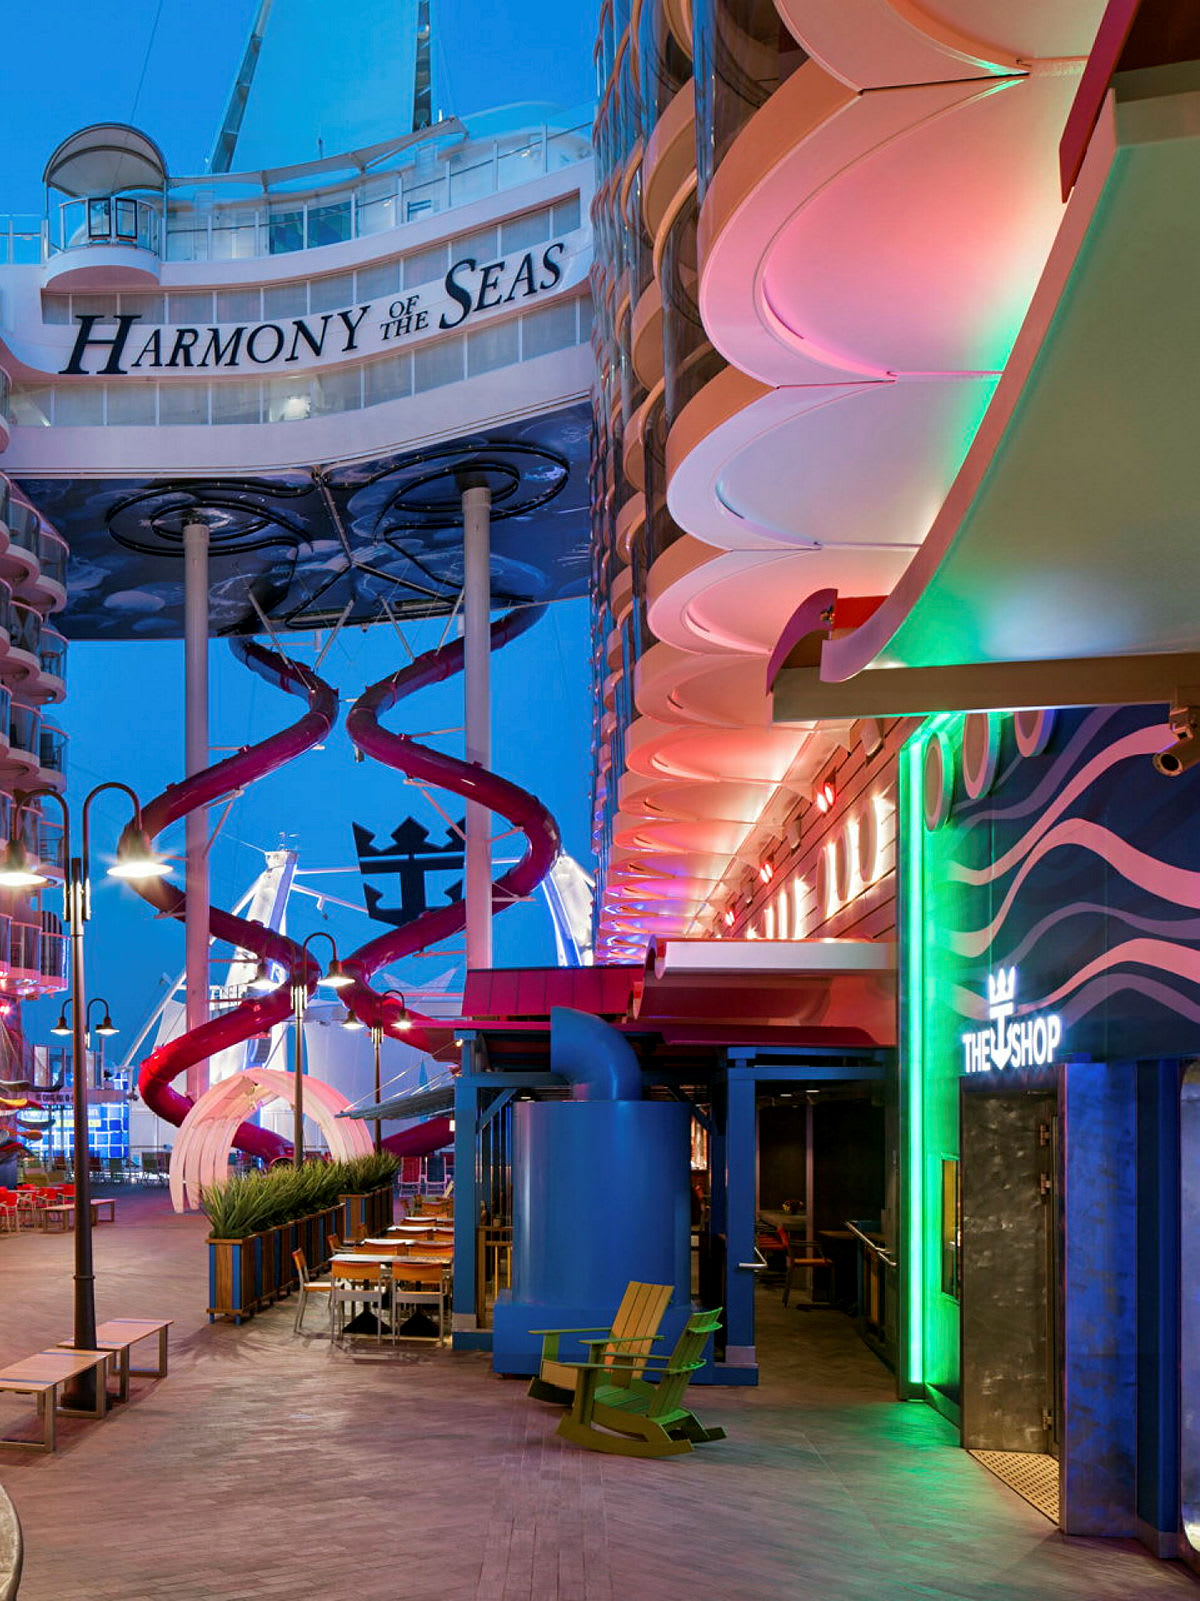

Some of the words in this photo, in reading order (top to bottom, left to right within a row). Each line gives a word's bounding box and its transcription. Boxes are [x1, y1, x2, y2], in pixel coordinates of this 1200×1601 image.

[388, 294, 420, 319] OF
[439, 242, 566, 330] SEAS
[58, 304, 370, 375] HARMONY
[379, 309, 430, 341] THE
[962, 1030, 991, 1073] THE
[1010, 1014, 1062, 1069] SHOP
